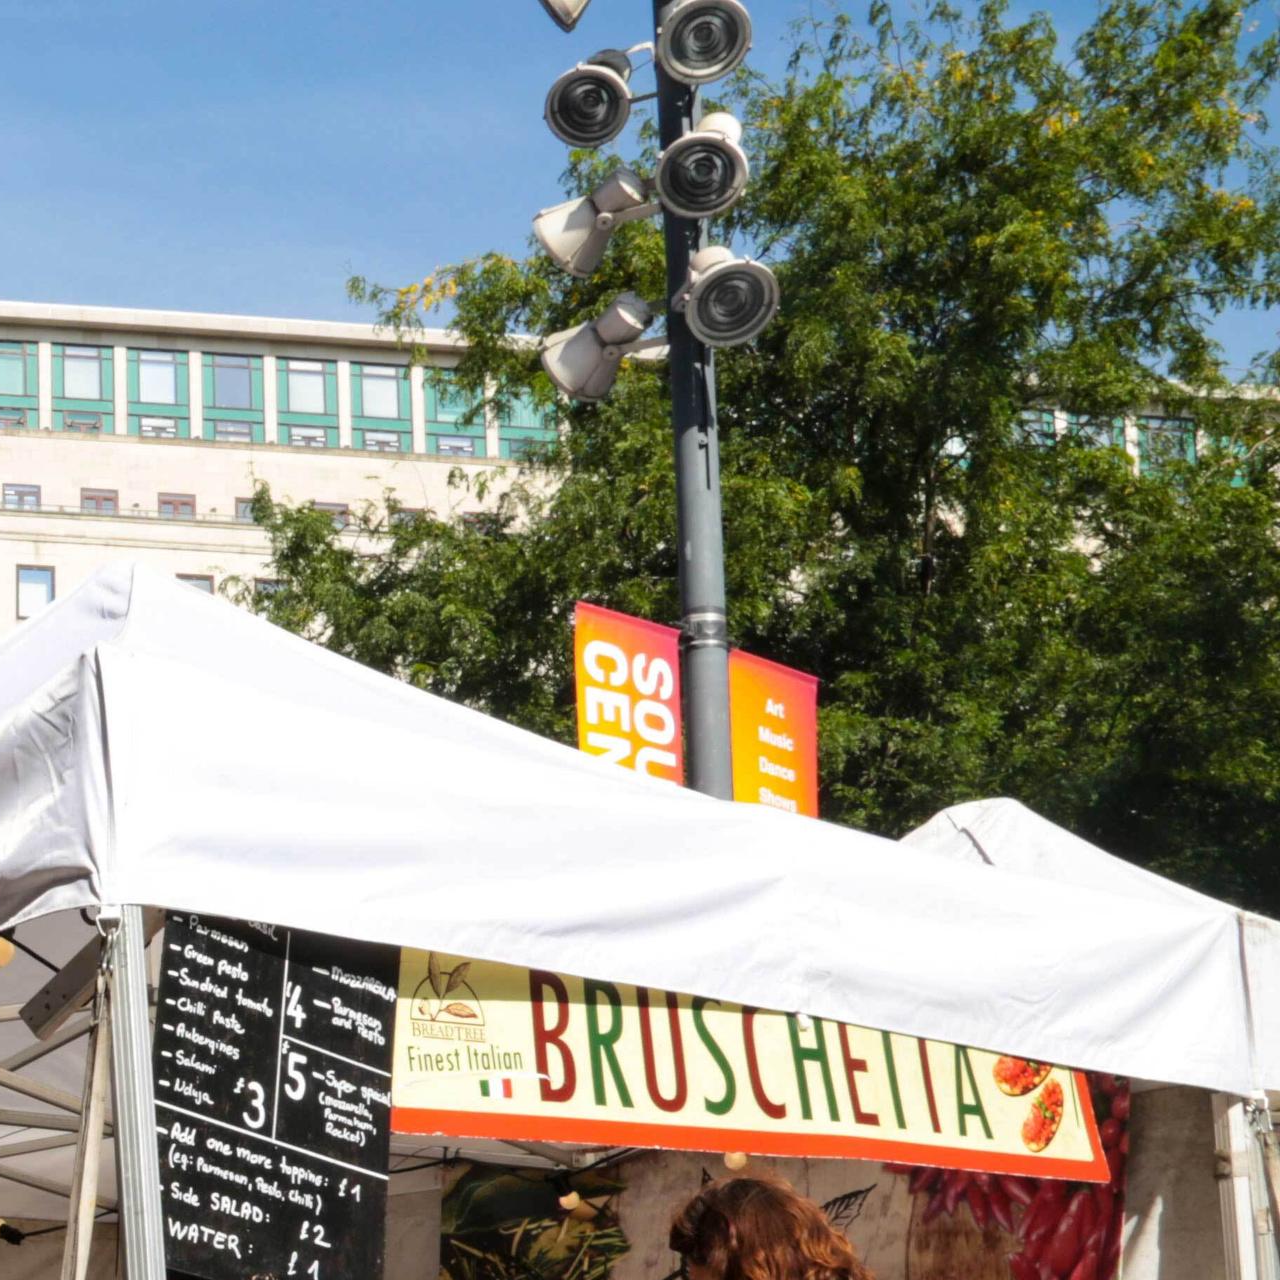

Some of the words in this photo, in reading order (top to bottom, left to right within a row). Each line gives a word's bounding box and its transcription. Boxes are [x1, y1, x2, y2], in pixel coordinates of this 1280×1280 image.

[765, 698, 785, 719] Art
[758, 725, 794, 751] Music
[758, 755, 796, 782] Dance
[184, 944, 214, 967] Green
[176, 997, 206, 1016] Chilli
[235, 988, 273, 1017] tomato
[331, 1015, 353, 1031] and
[175, 1022, 240, 1060] Aubergines
[175, 1050, 217, 1075] Salami
[407, 1045, 460, 1072] Finest
[466, 1043, 524, 1071] Italian
[174, 1077, 214, 1106] Nduja
[325, 1069, 357, 1104] Super
[170, 1121, 197, 1146] Add
[206, 1136, 233, 1157] one
[236, 1145, 273, 1170] more
[170, 1181, 200, 1207] Side
[211, 1191, 271, 1223] SALAD:
[299, 1220, 332, 1248] £2
